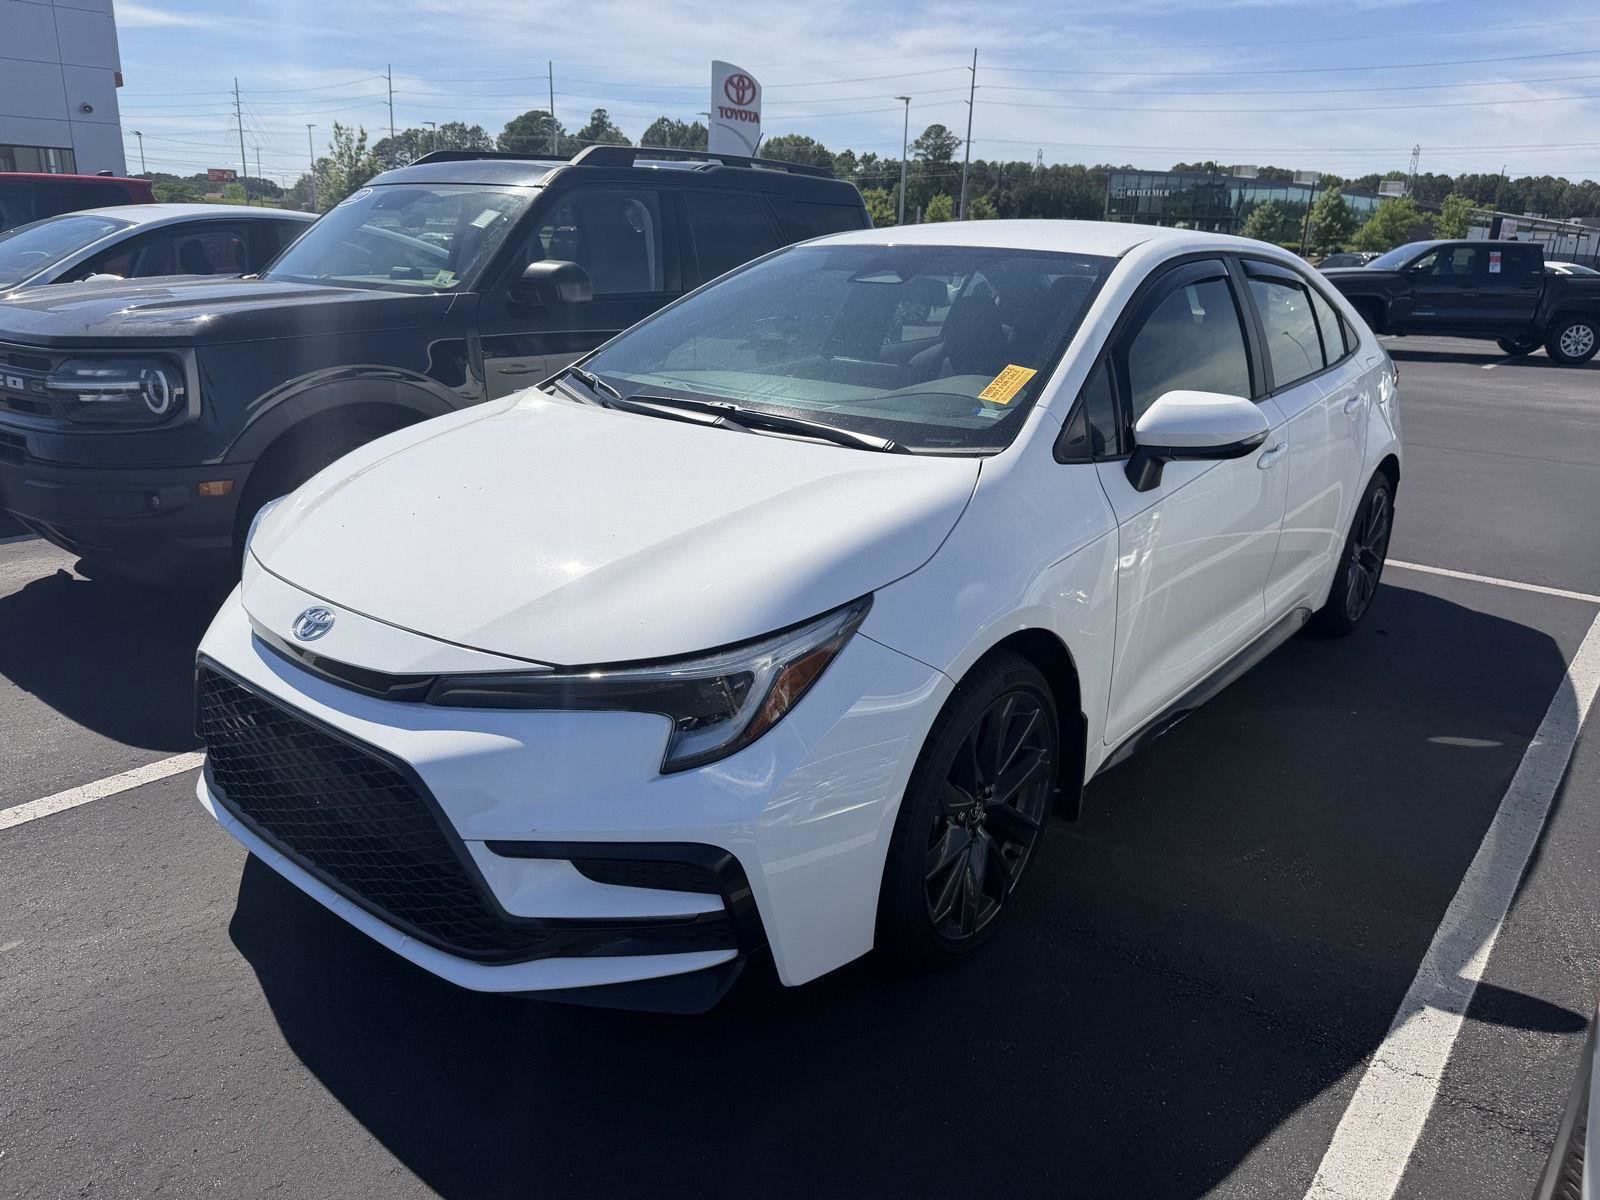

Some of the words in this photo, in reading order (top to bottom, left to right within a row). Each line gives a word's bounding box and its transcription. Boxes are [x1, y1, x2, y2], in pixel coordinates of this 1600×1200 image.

[718, 106, 760, 123] TOYOTA
[1126, 189, 1170, 197] REDEEMER
[981, 386, 996, 398] THIS
